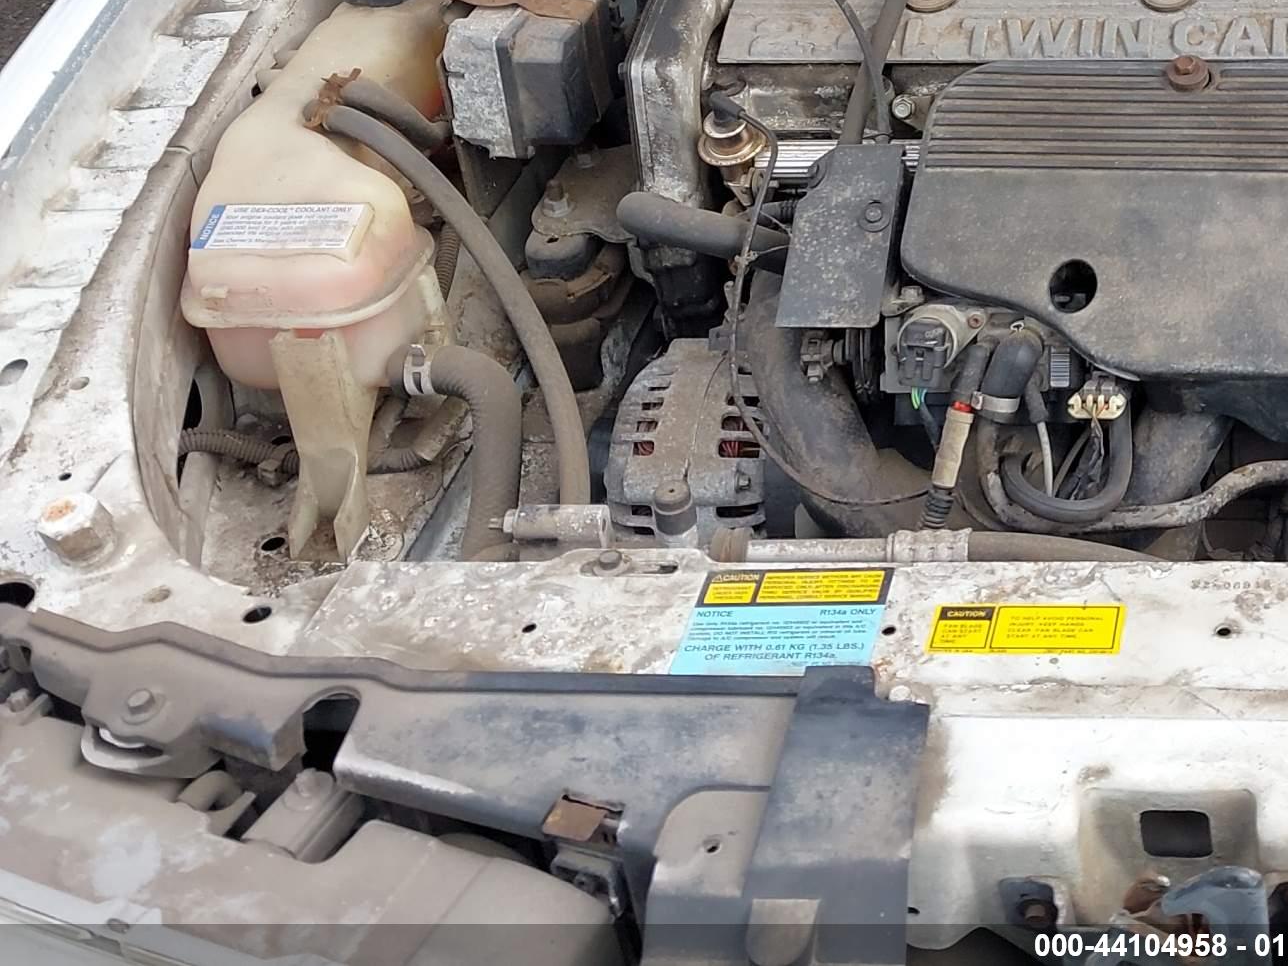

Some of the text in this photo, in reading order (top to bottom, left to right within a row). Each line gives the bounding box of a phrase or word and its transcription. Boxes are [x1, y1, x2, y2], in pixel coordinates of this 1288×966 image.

[961, 16, 1156, 59] TWIN
[199, 213, 220, 240] NOTICE
[723, 573, 760, 582] CAUTION
[696, 610, 734, 618] NOTICE
[819, 608, 878, 616] R134a ONLY
[946, 610, 986, 618] CAUTION
[684, 644, 732, 652] CHARGE
[734, 643, 763, 651] WITH
[789, 643, 805, 651] KG
[836, 642, 865, 651] LBS.)
[704, 653, 721, 661] OF
[722, 652, 801, 661] REFRIGERANT
